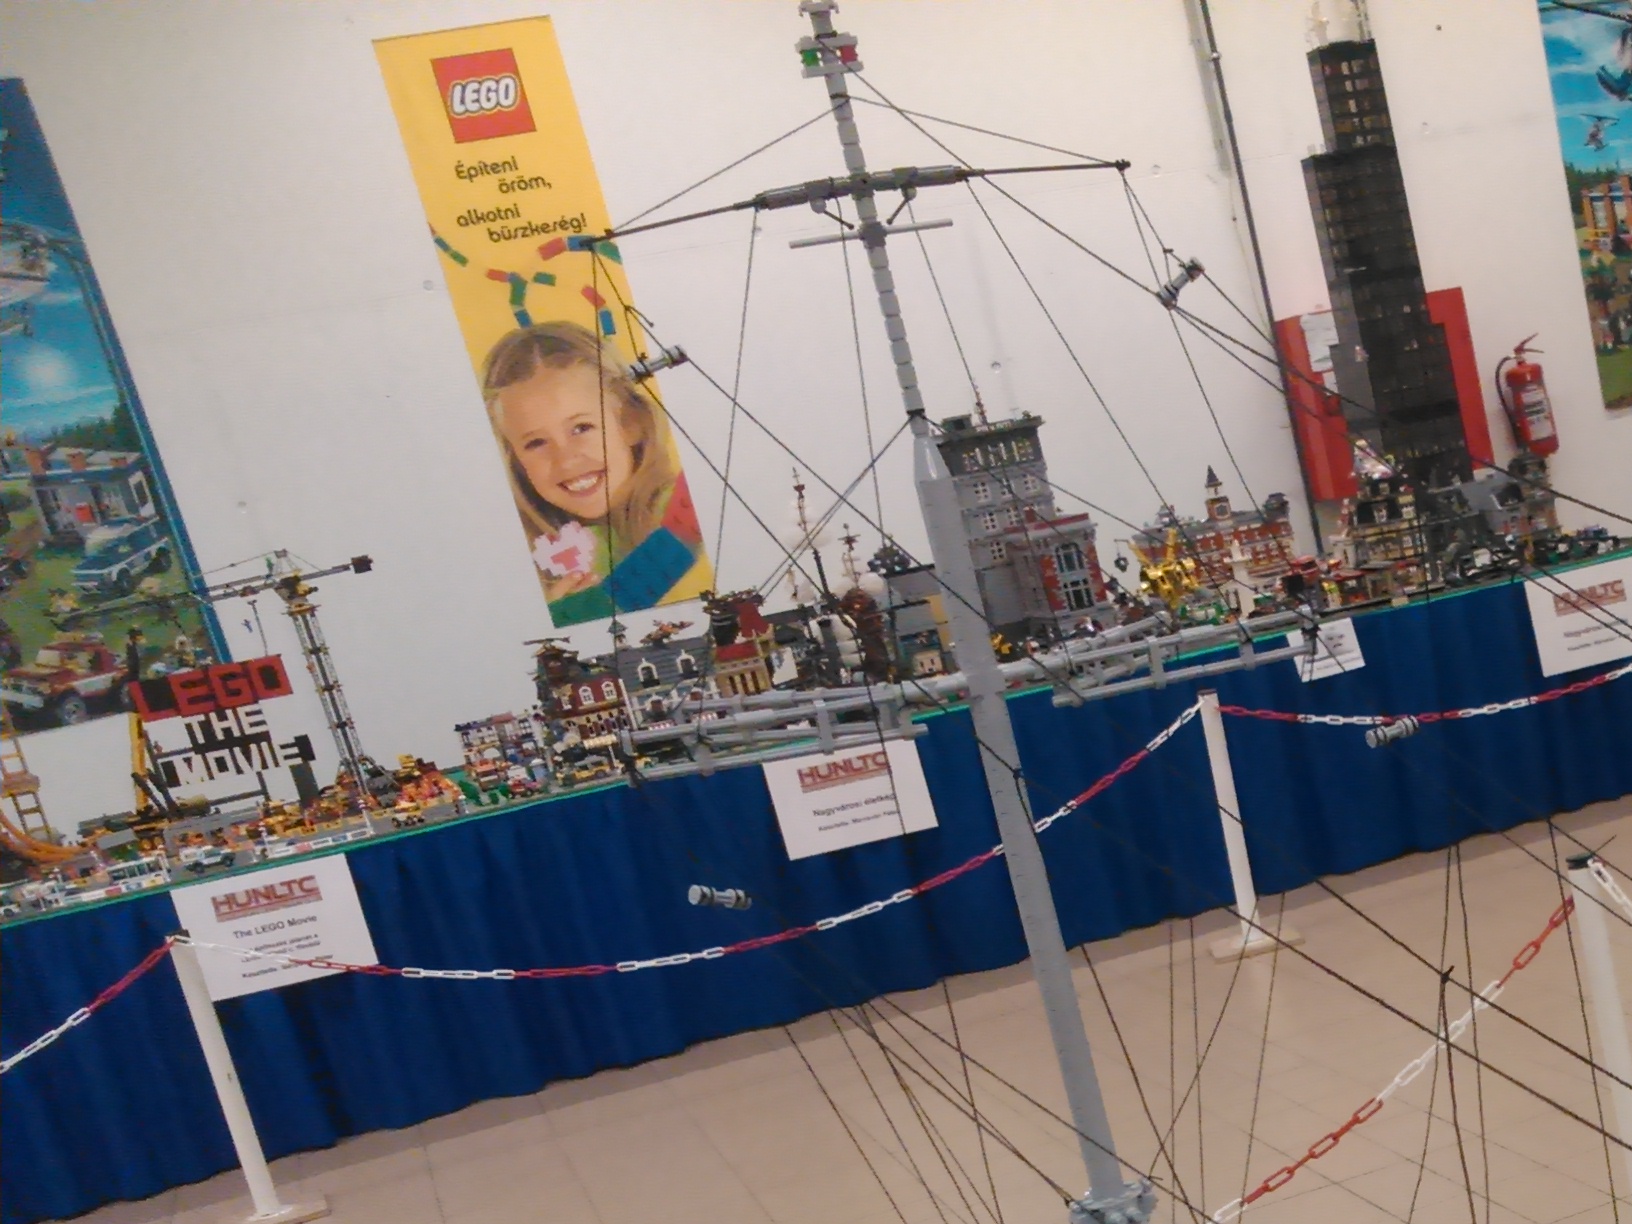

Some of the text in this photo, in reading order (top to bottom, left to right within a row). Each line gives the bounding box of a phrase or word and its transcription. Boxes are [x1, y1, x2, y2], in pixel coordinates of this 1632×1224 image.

[451, 76, 518, 116] LEGO
[455, 156, 519, 183] Építeni
[498, 175, 552, 194] öröm,
[457, 203, 521, 228] alkotni
[487, 213, 587, 243] büszkeség!
[128, 654, 294, 723] LEGO
[183, 703, 269, 746] THE
[157, 735, 304, 789] MOVIE
[211, 875, 319, 913] HUNLTC
[254, 921, 285, 935] LEGO
[287, 915, 317, 927] Movie
